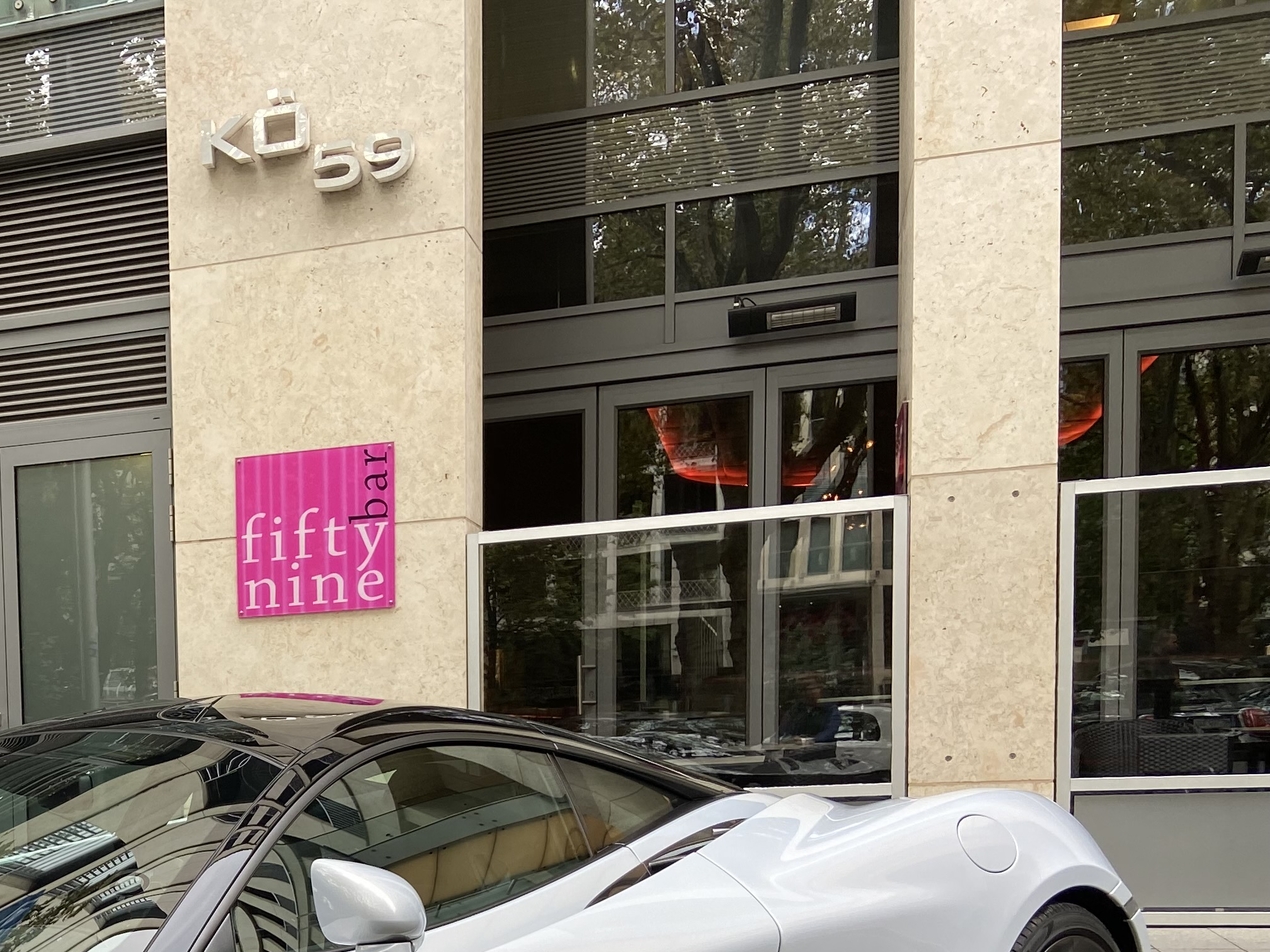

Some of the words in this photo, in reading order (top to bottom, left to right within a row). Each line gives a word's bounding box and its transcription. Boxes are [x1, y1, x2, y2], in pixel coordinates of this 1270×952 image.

[348, 448, 389, 525] bar
[241, 507, 389, 572] fifty
[244, 562, 385, 610] nine
